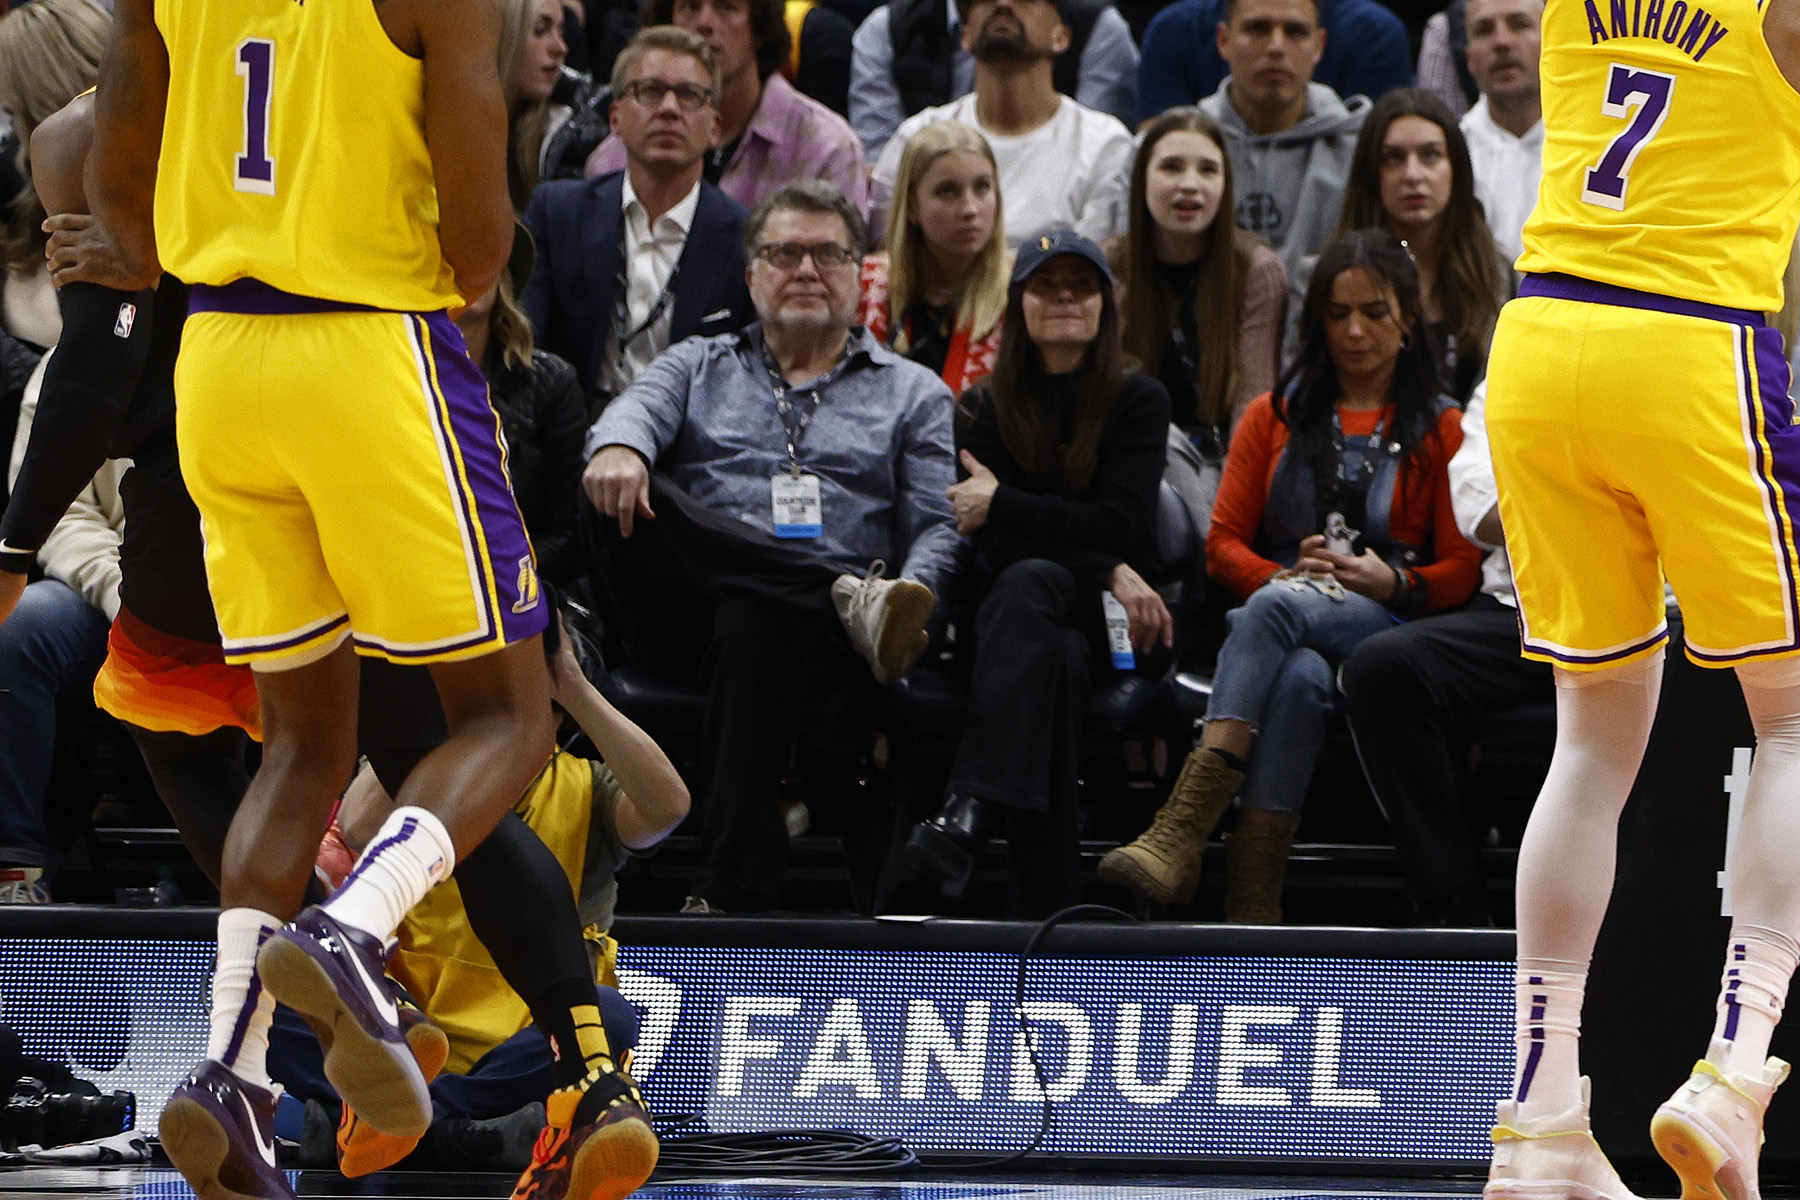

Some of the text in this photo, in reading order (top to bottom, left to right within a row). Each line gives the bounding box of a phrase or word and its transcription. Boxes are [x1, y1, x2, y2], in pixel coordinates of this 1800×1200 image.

[232, 37, 277, 197] 1
[1580, 62, 1677, 212] 7
[715, 996, 1382, 1109] FANDUEL
